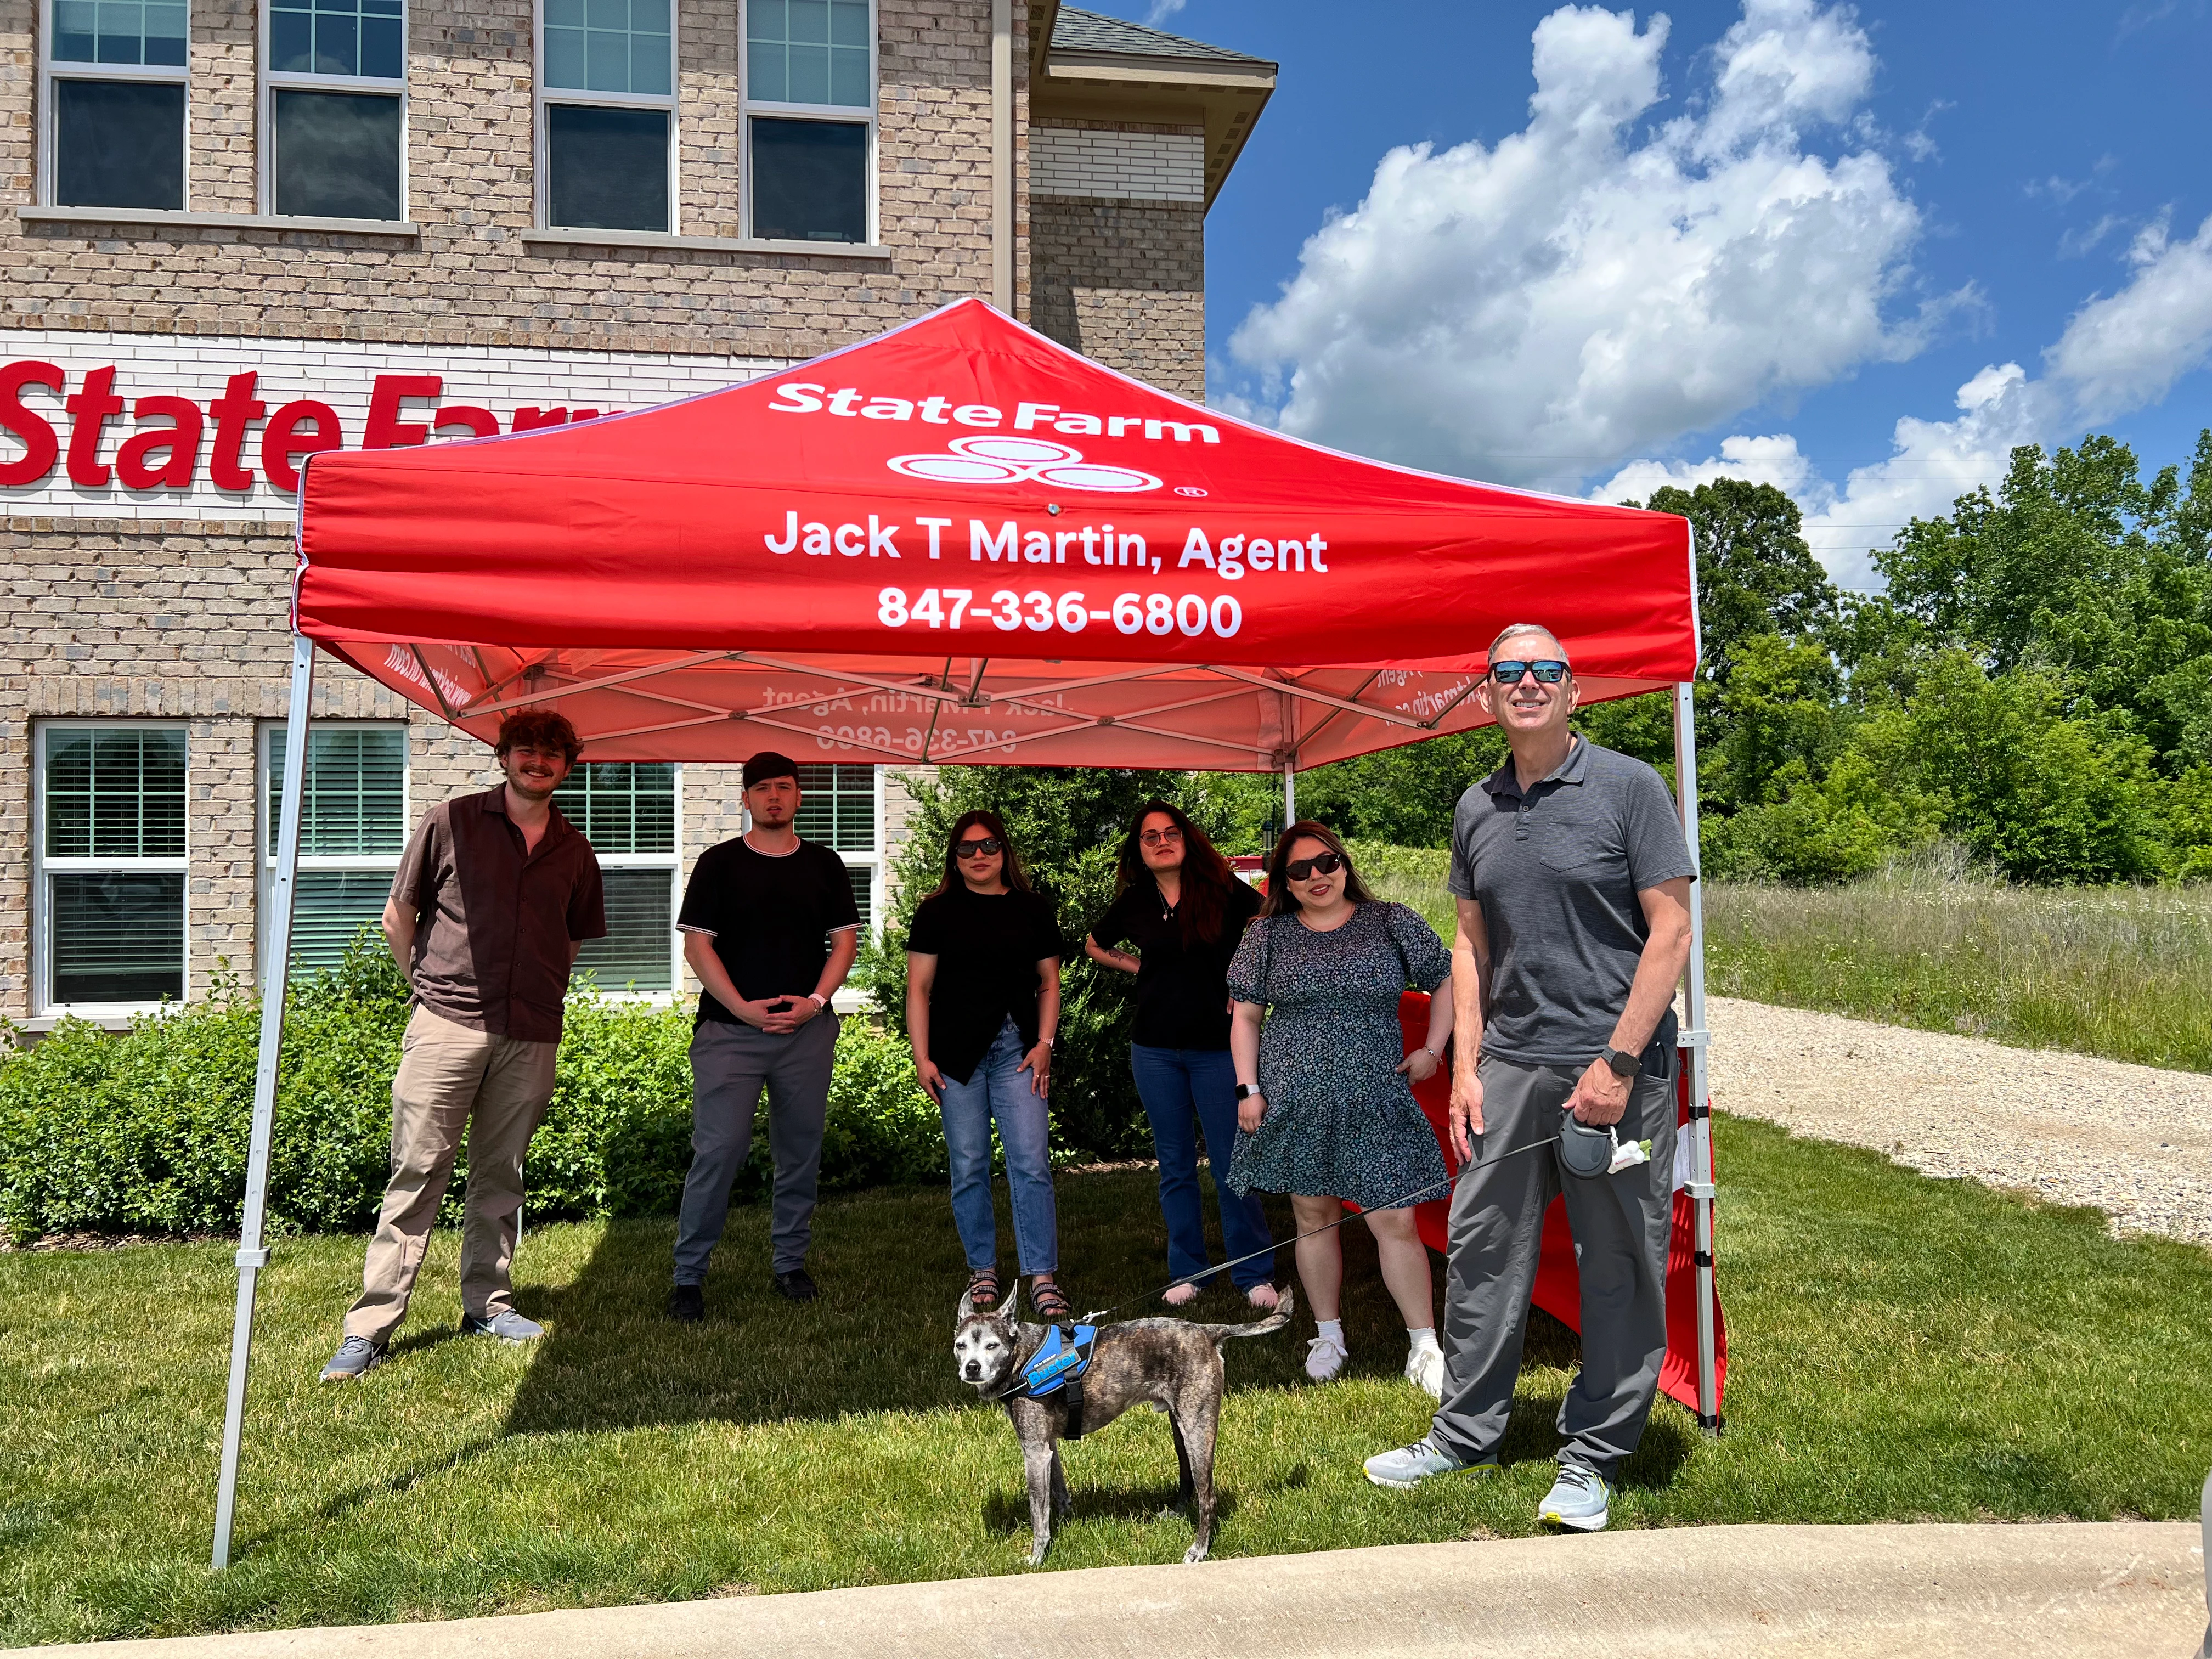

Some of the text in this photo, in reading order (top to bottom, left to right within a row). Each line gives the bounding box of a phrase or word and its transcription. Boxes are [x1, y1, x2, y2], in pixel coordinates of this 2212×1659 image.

[0, 361, 341, 491] State
[768, 383, 1220, 443] State Farm
[764, 504, 1328, 580] Jack T Martin, Agent
[877, 587, 1242, 638] 847-336-6800
[1028, 1352, 1075, 1386] Buster
